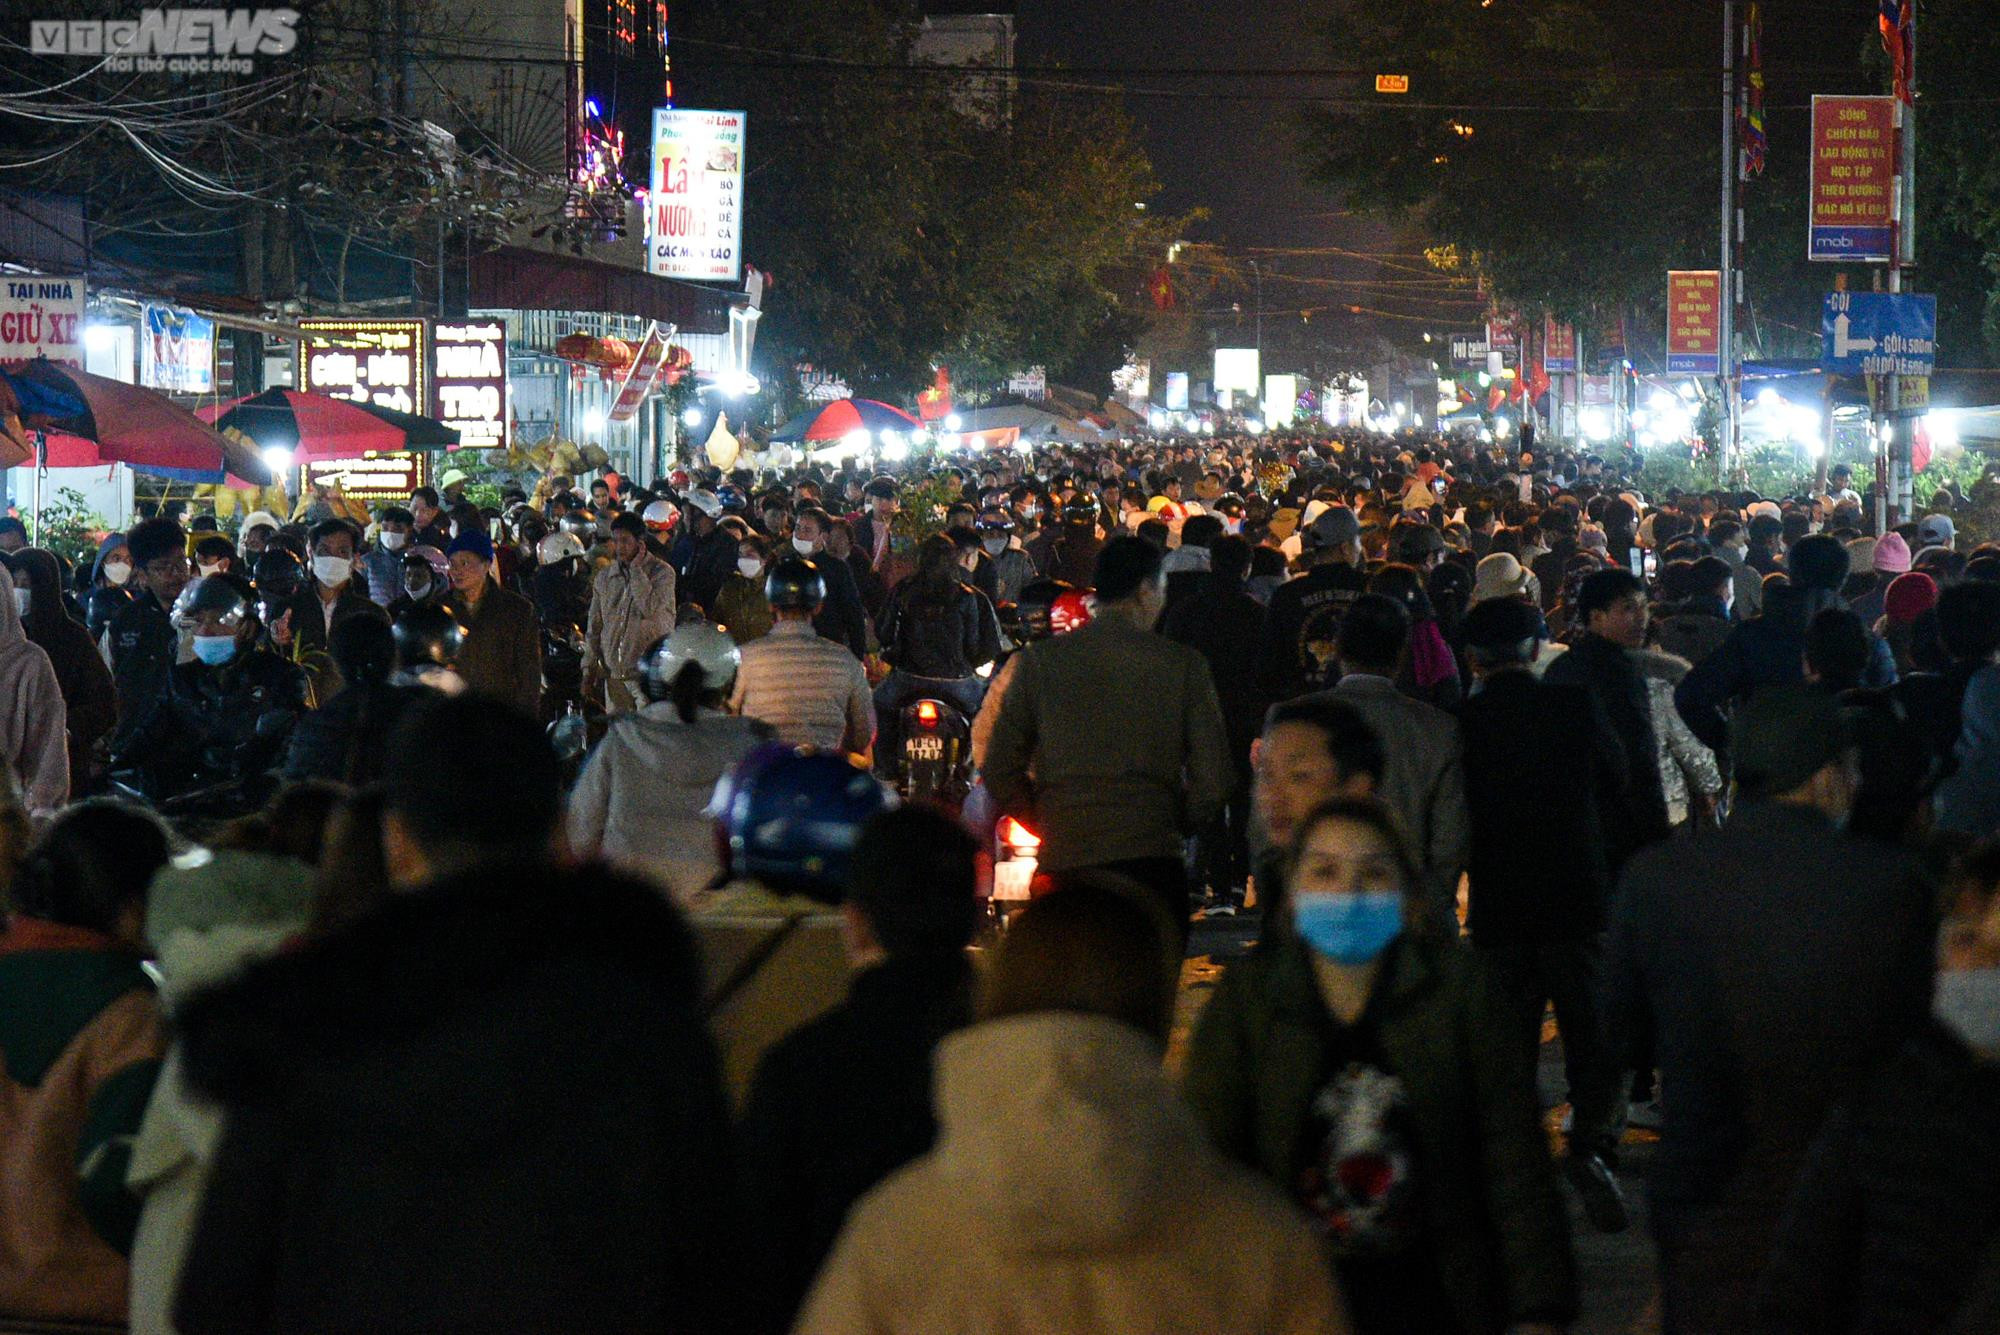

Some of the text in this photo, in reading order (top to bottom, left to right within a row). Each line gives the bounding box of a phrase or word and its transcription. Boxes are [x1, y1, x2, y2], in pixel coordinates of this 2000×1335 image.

[8, 281, 73, 301] TẠI NHÀ
[0, 303, 79, 344] GIỮ XE
